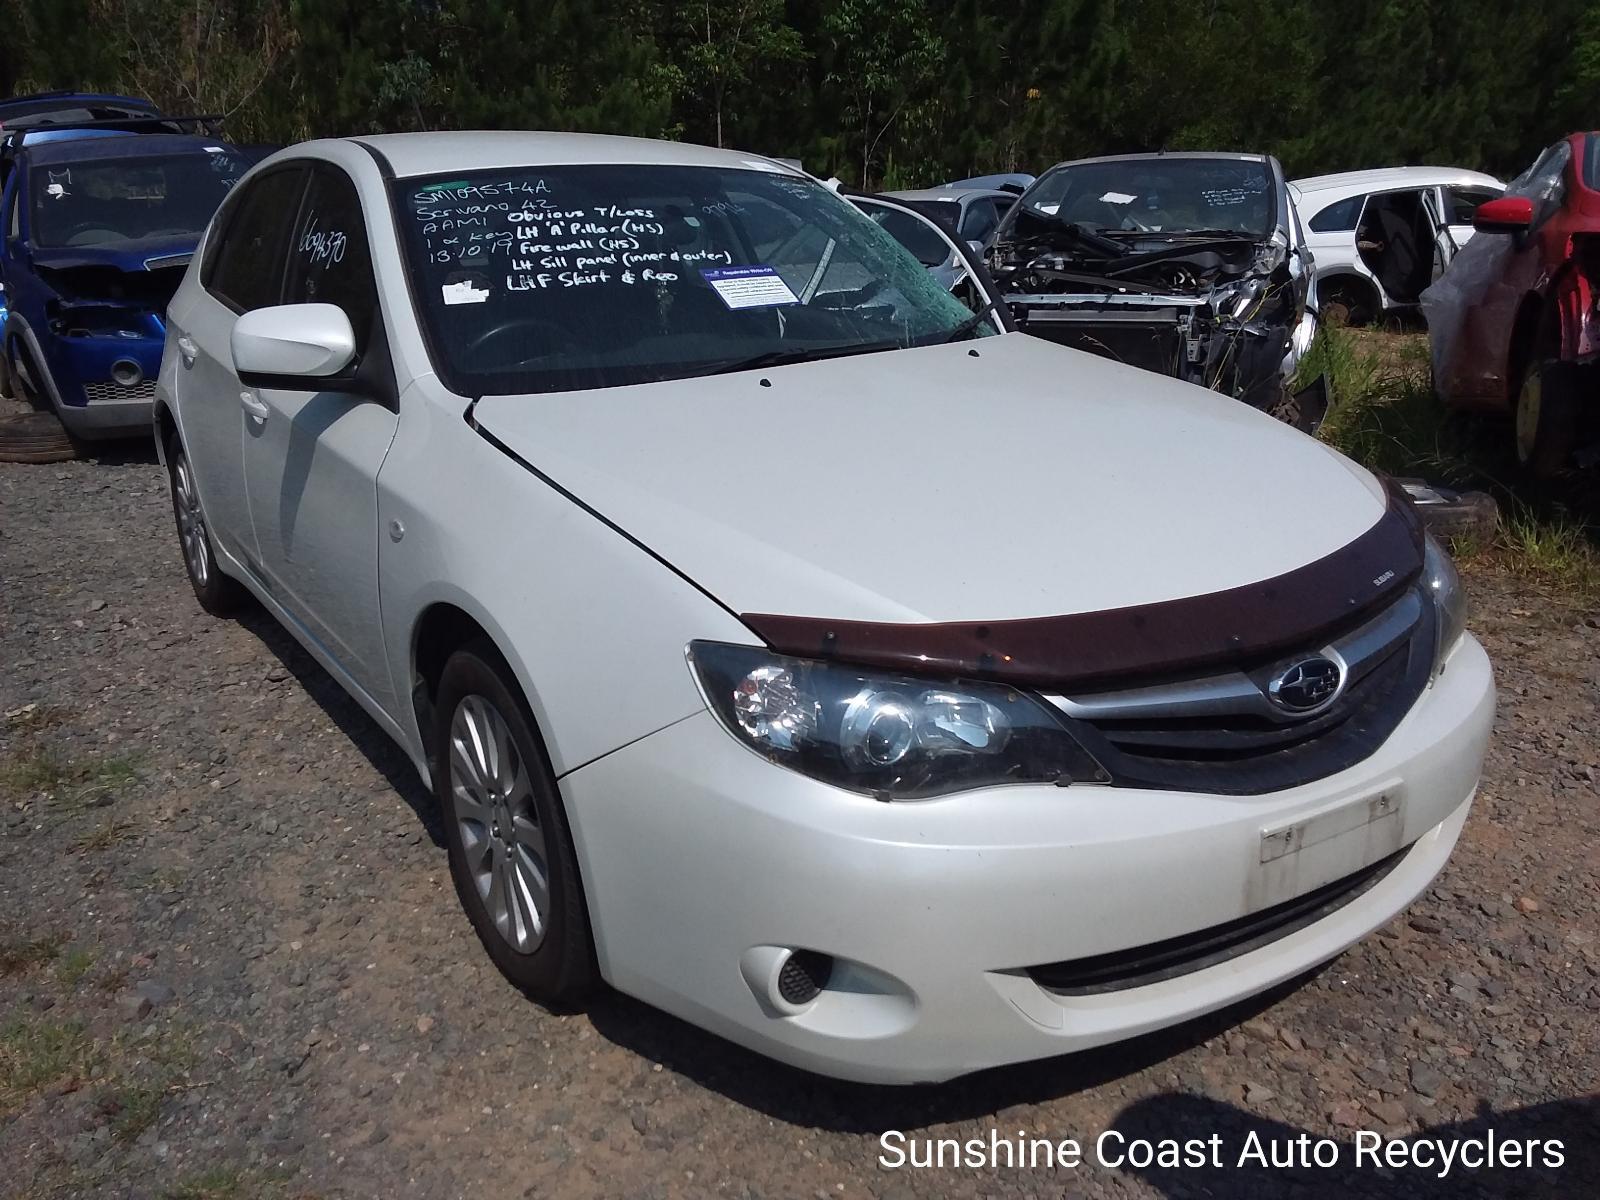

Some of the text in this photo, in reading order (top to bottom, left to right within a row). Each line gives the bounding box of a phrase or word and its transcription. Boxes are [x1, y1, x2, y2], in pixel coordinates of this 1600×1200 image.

[521, 199, 558, 210] 42
[516, 225, 539, 240] LH
[512, 258, 534, 271] LH
[576, 253, 618, 270] panel
